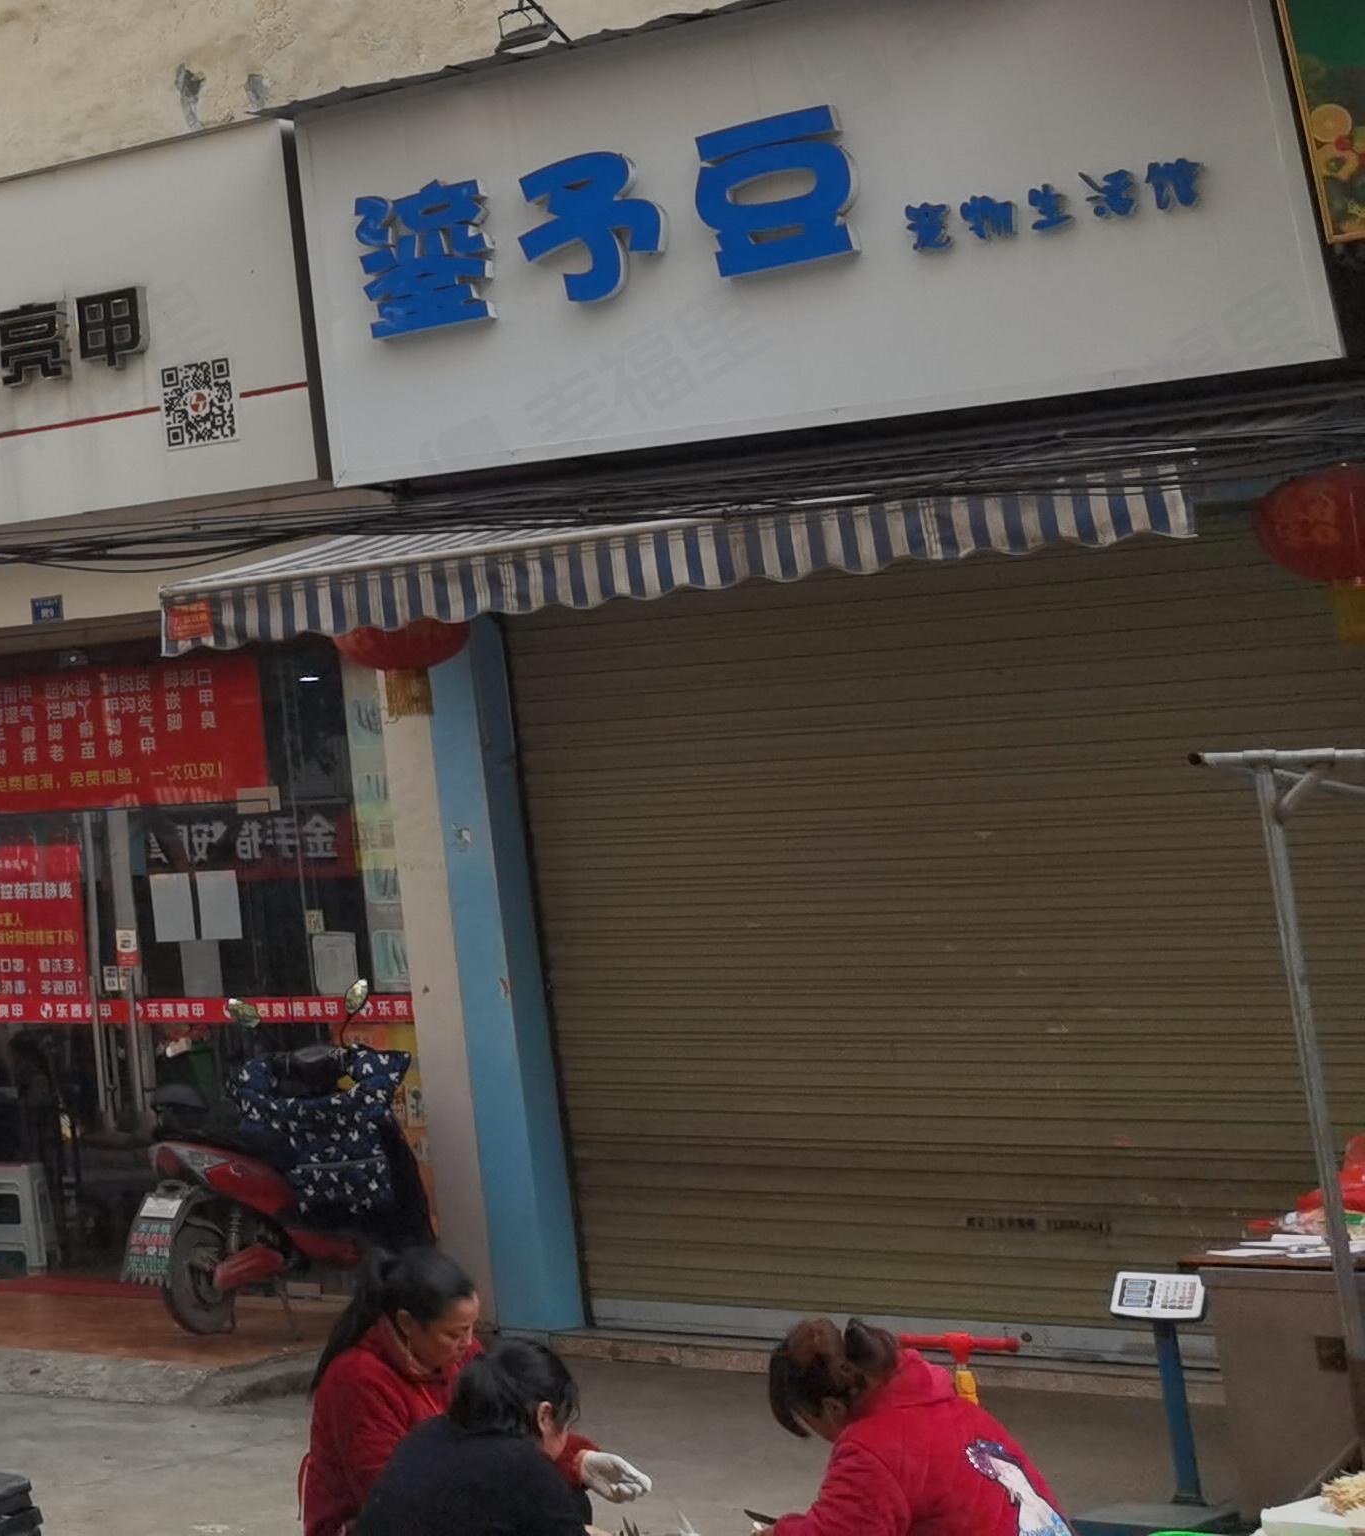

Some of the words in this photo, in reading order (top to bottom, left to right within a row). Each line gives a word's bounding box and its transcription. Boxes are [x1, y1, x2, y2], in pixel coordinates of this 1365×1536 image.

[904, 158, 1205, 252] 宠物生活馆
[147, 1002, 205, 1018] 乐泰亮甲
